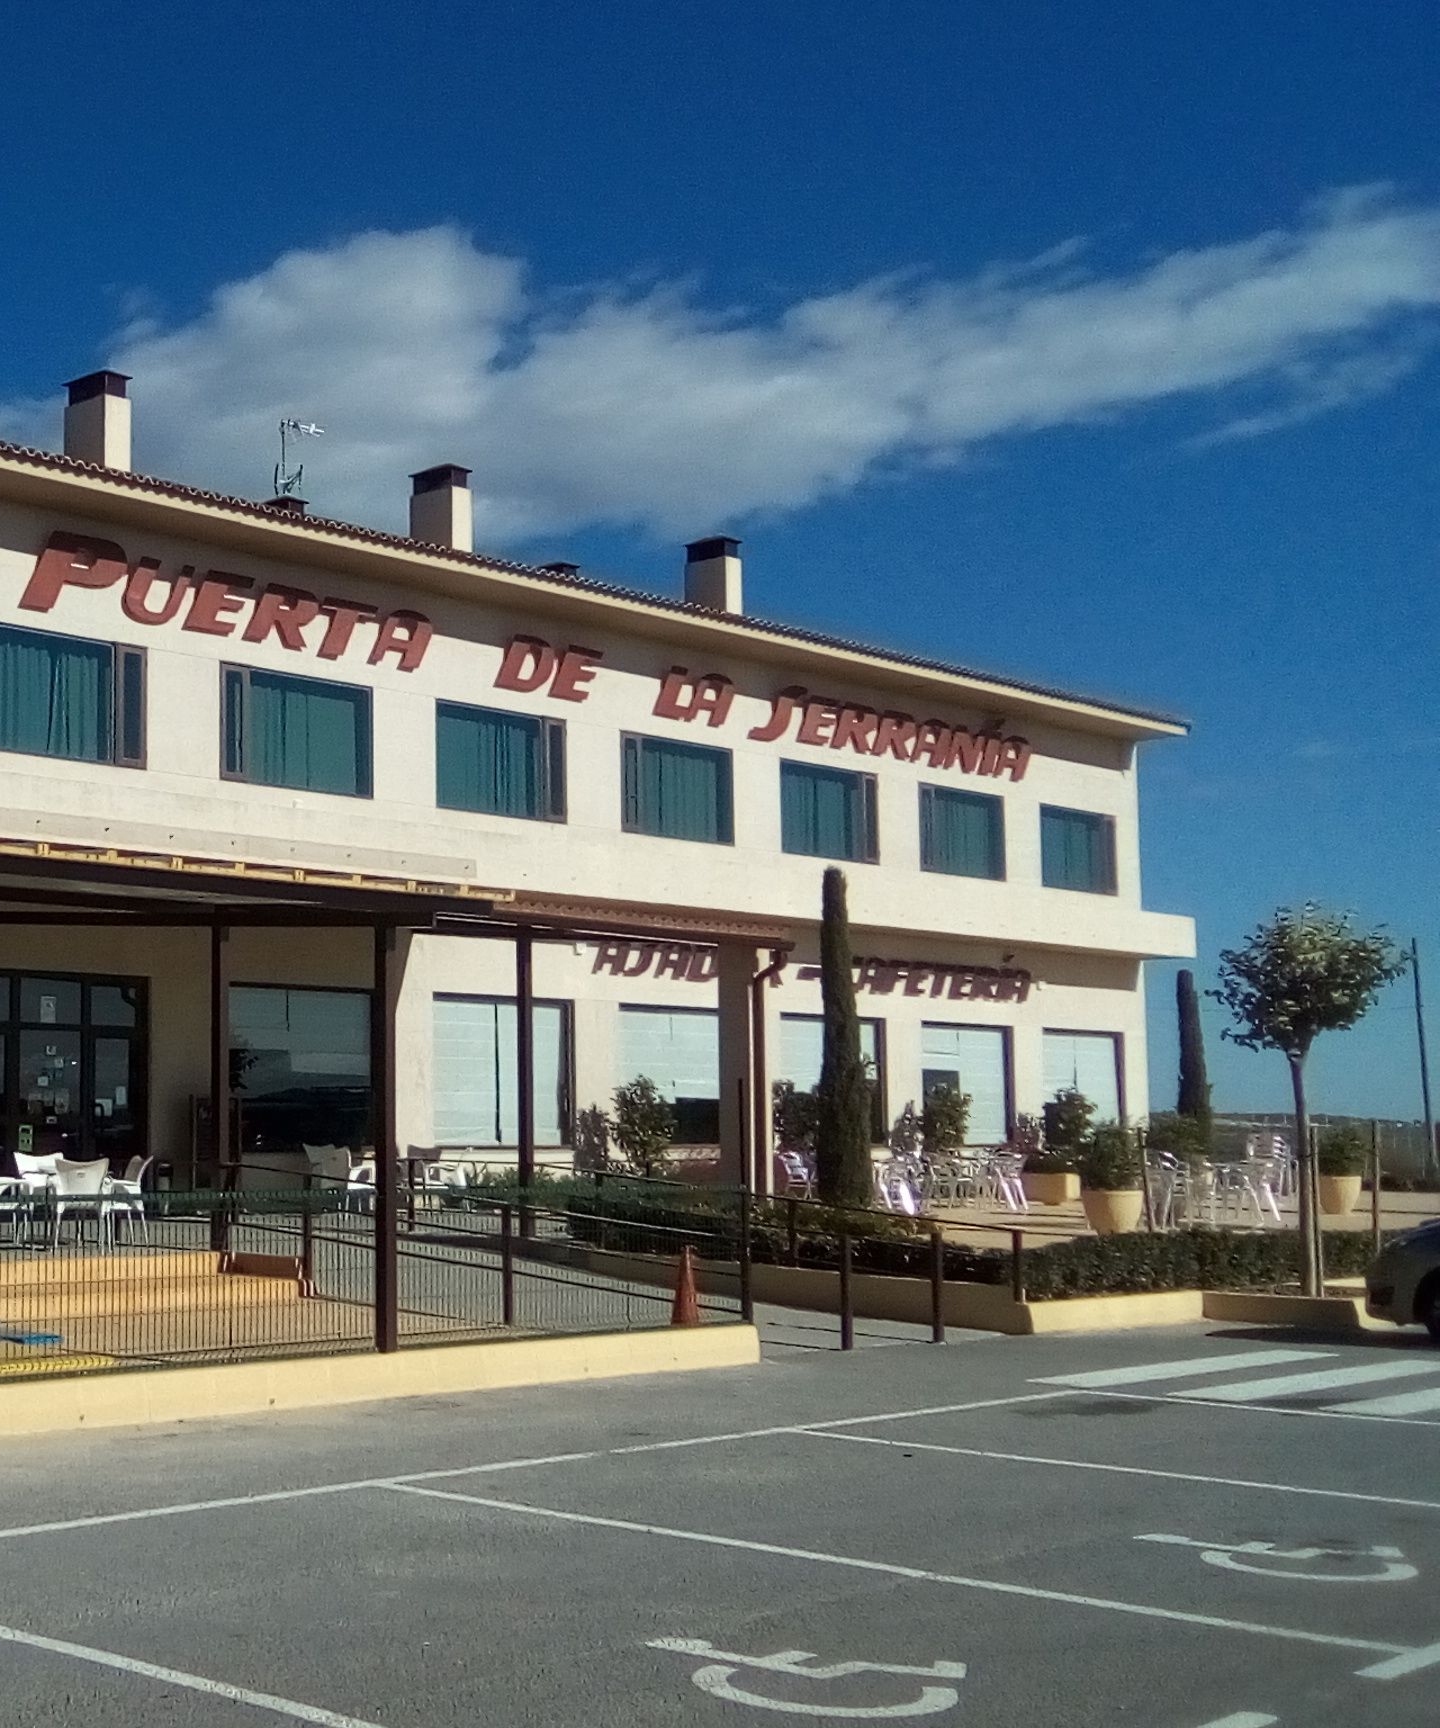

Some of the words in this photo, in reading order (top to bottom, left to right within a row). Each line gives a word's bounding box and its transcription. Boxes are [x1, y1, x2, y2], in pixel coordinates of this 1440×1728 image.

[17, 530, 433, 673] PUERTA
[493, 633, 604, 703] DE
[652, 665, 735, 728] LA
[747, 684, 1032, 783] SERRANÍA
[852, 952, 1032, 1004] AFETERÍA
